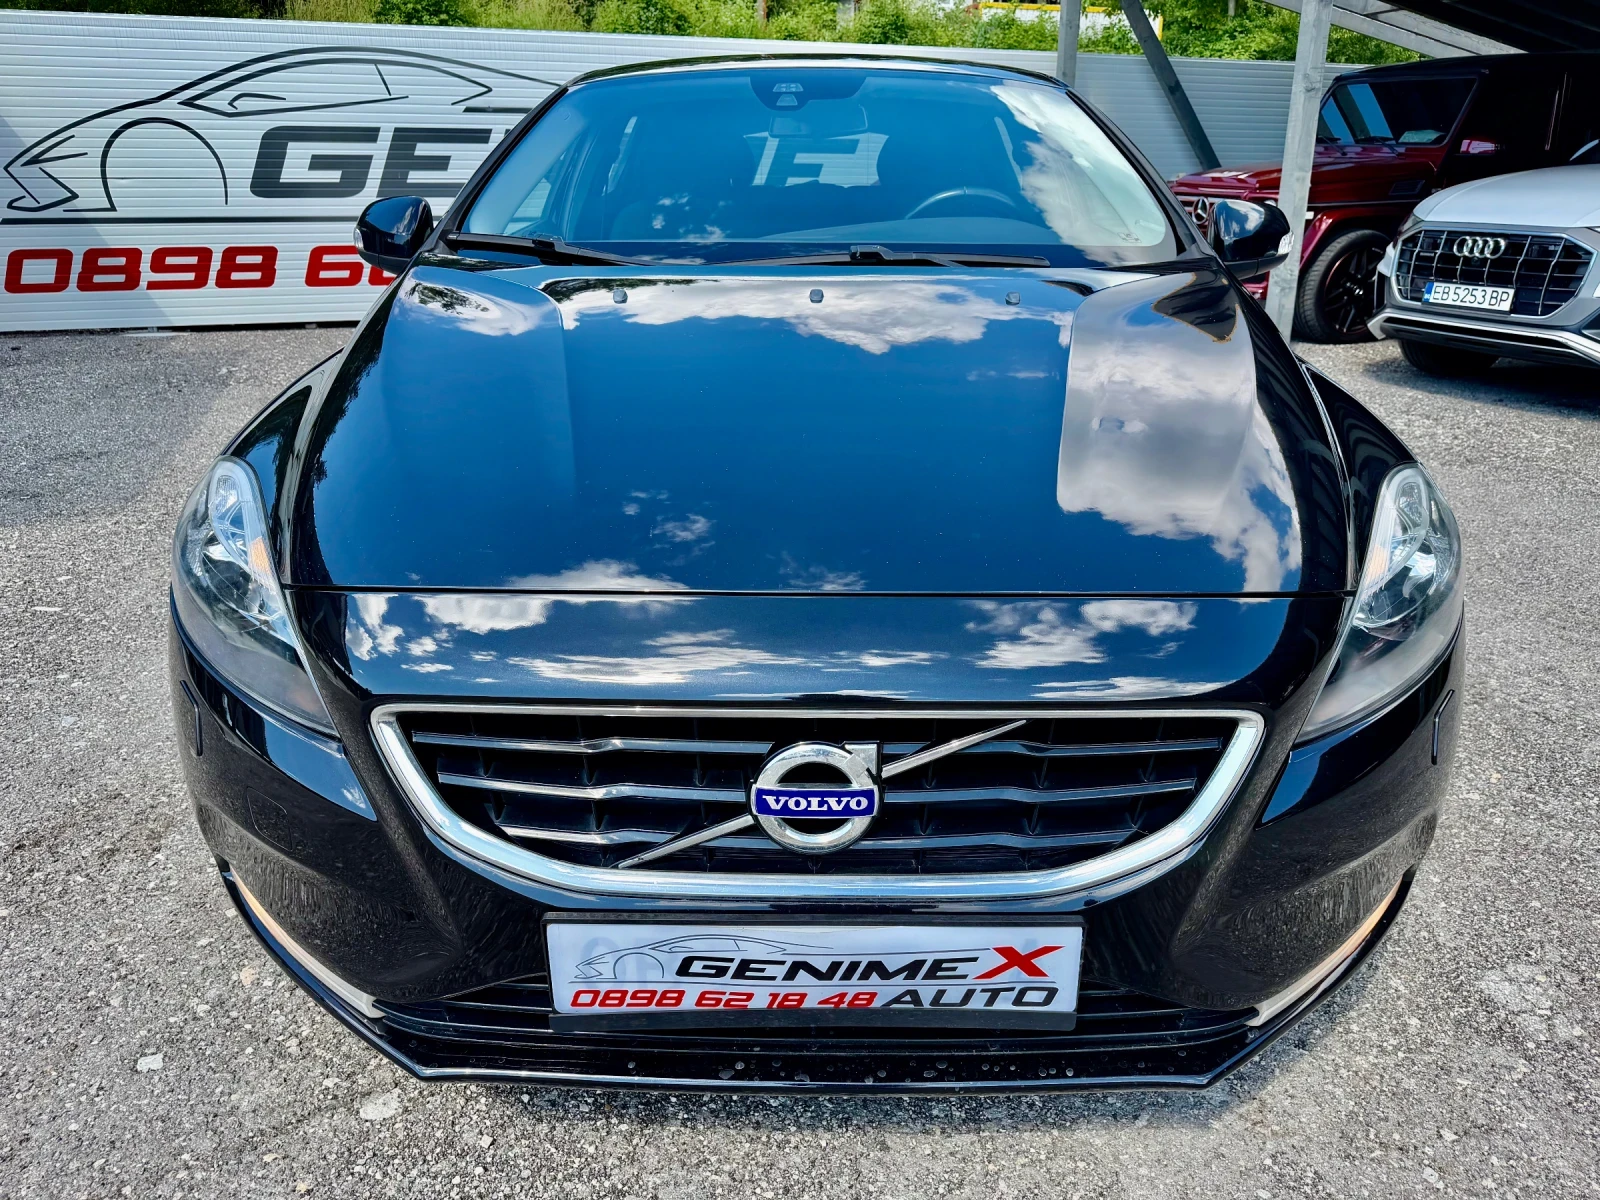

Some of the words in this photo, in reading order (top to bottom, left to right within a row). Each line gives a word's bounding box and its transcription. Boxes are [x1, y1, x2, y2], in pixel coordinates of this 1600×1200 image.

[250, 125, 510, 198] GE
[4, 246, 278, 294] 0898
[762, 795, 868, 811] VOLVO
[675, 945, 1066, 981] GENIMEX
[570, 989, 686, 1008] 0898
[694, 990, 755, 1009] 62
[766, 992, 808, 1009] 18
[817, 992, 878, 1008] 48
[880, 986, 1059, 1008] AUTO
